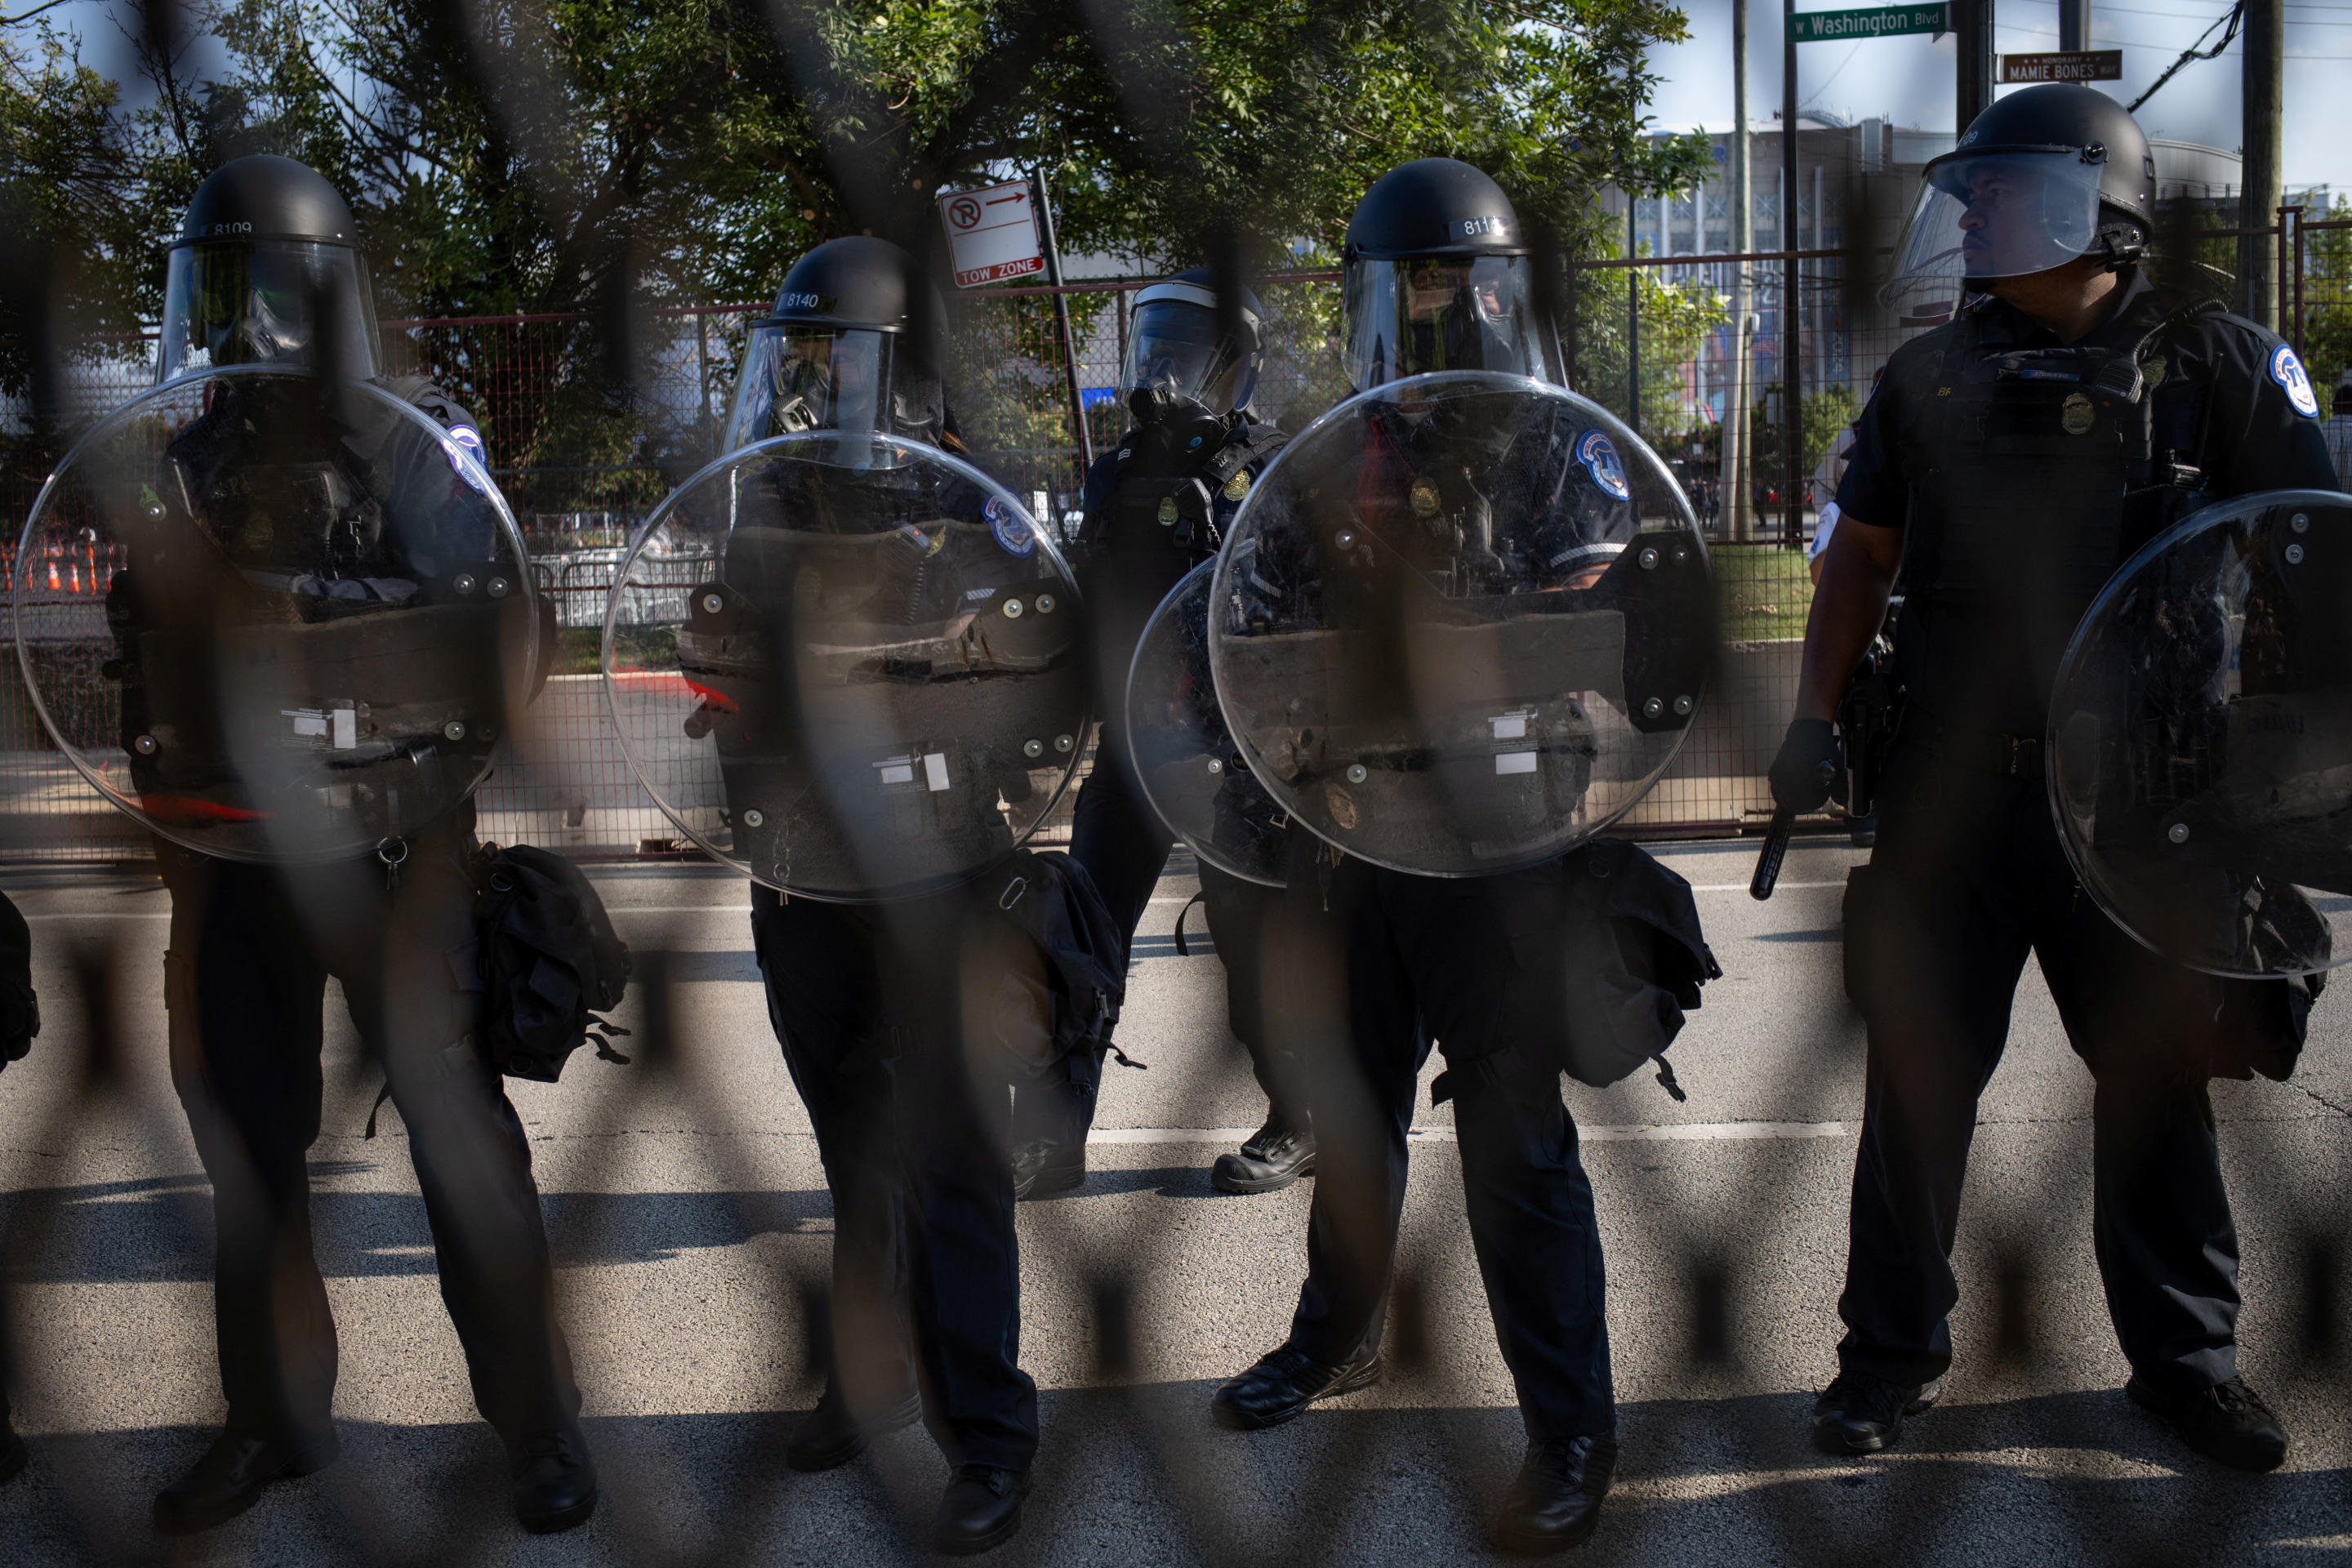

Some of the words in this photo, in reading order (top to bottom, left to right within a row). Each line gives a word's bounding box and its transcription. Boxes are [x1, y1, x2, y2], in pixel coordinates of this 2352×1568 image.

[1796, 22, 1804, 34] W
[1811, 11, 1908, 36] Washington
[1915, 12, 1939, 25] Blvd
[2042, 56, 2082, 65] HONORARY
[2010, 65, 2051, 80] MAMIE
[2055, 65, 2095, 79] BONES
[961, 268, 991, 284] TOW
[998, 258, 1037, 277] ZONE
[787, 293, 818, 308] 8140
